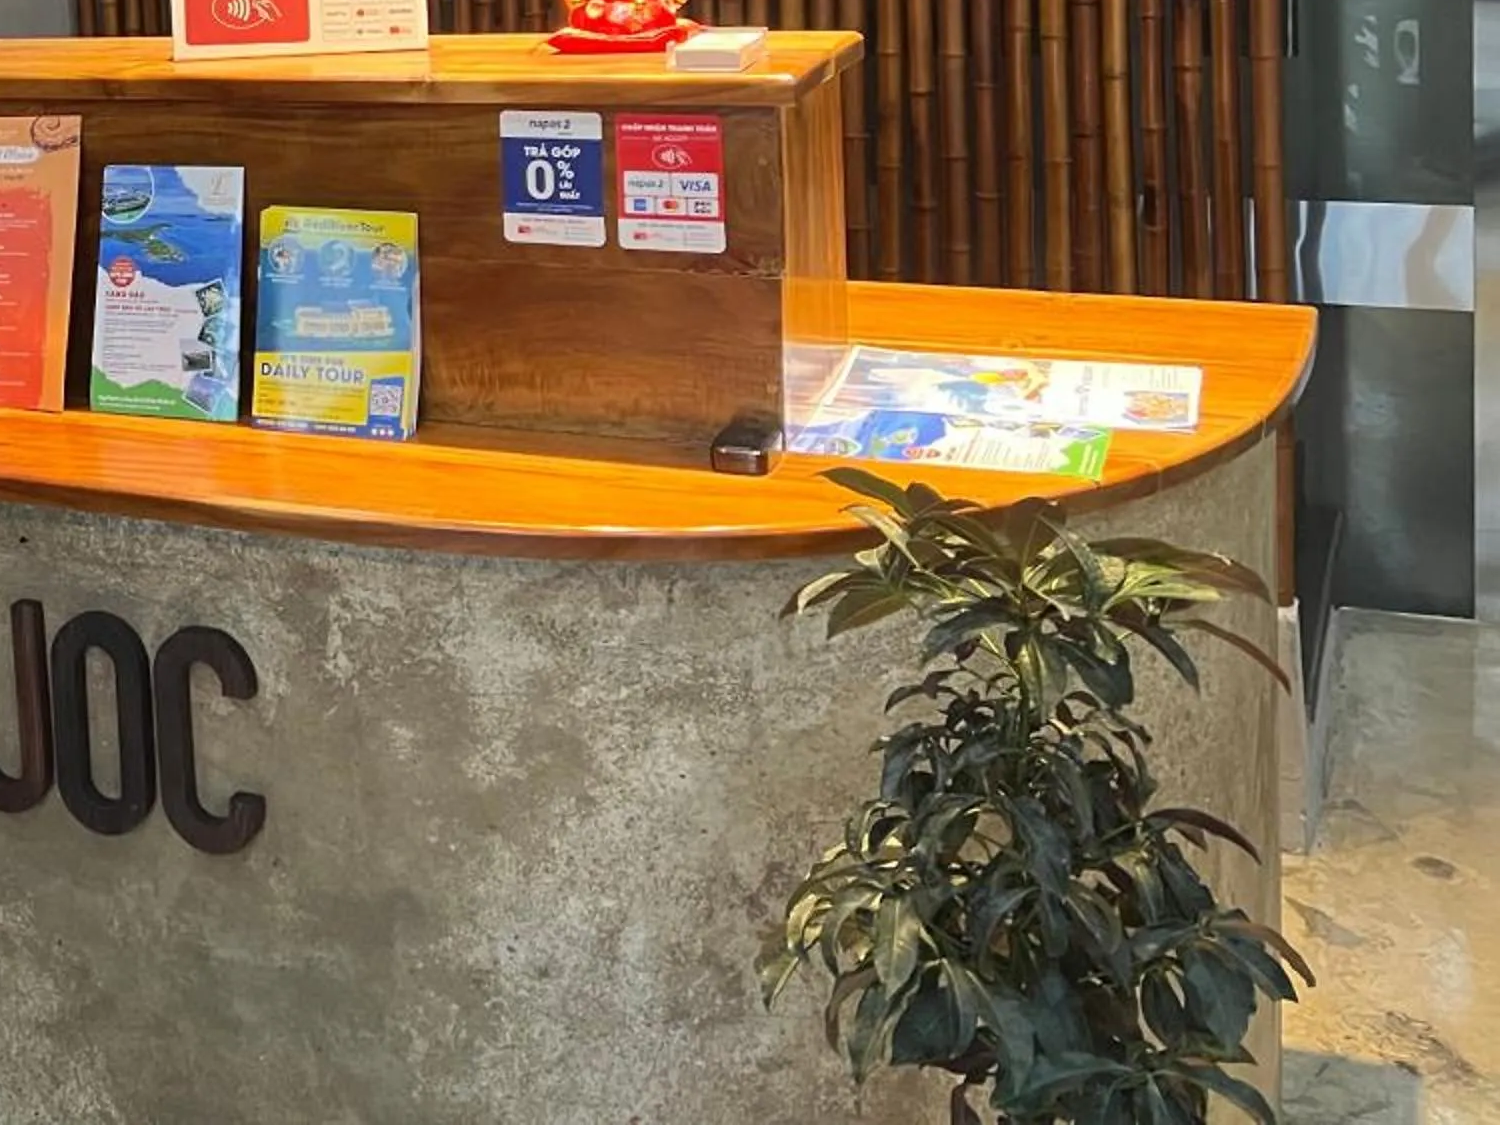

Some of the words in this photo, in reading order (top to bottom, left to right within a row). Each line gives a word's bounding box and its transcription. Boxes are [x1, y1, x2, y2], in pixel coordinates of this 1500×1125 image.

[523, 142, 548, 158] TRẢ
[551, 144, 582, 158] GÓP
[679, 178, 712, 192] VISA
[261, 361, 309, 380] DAILY
[315, 366, 365, 385] TOUR
